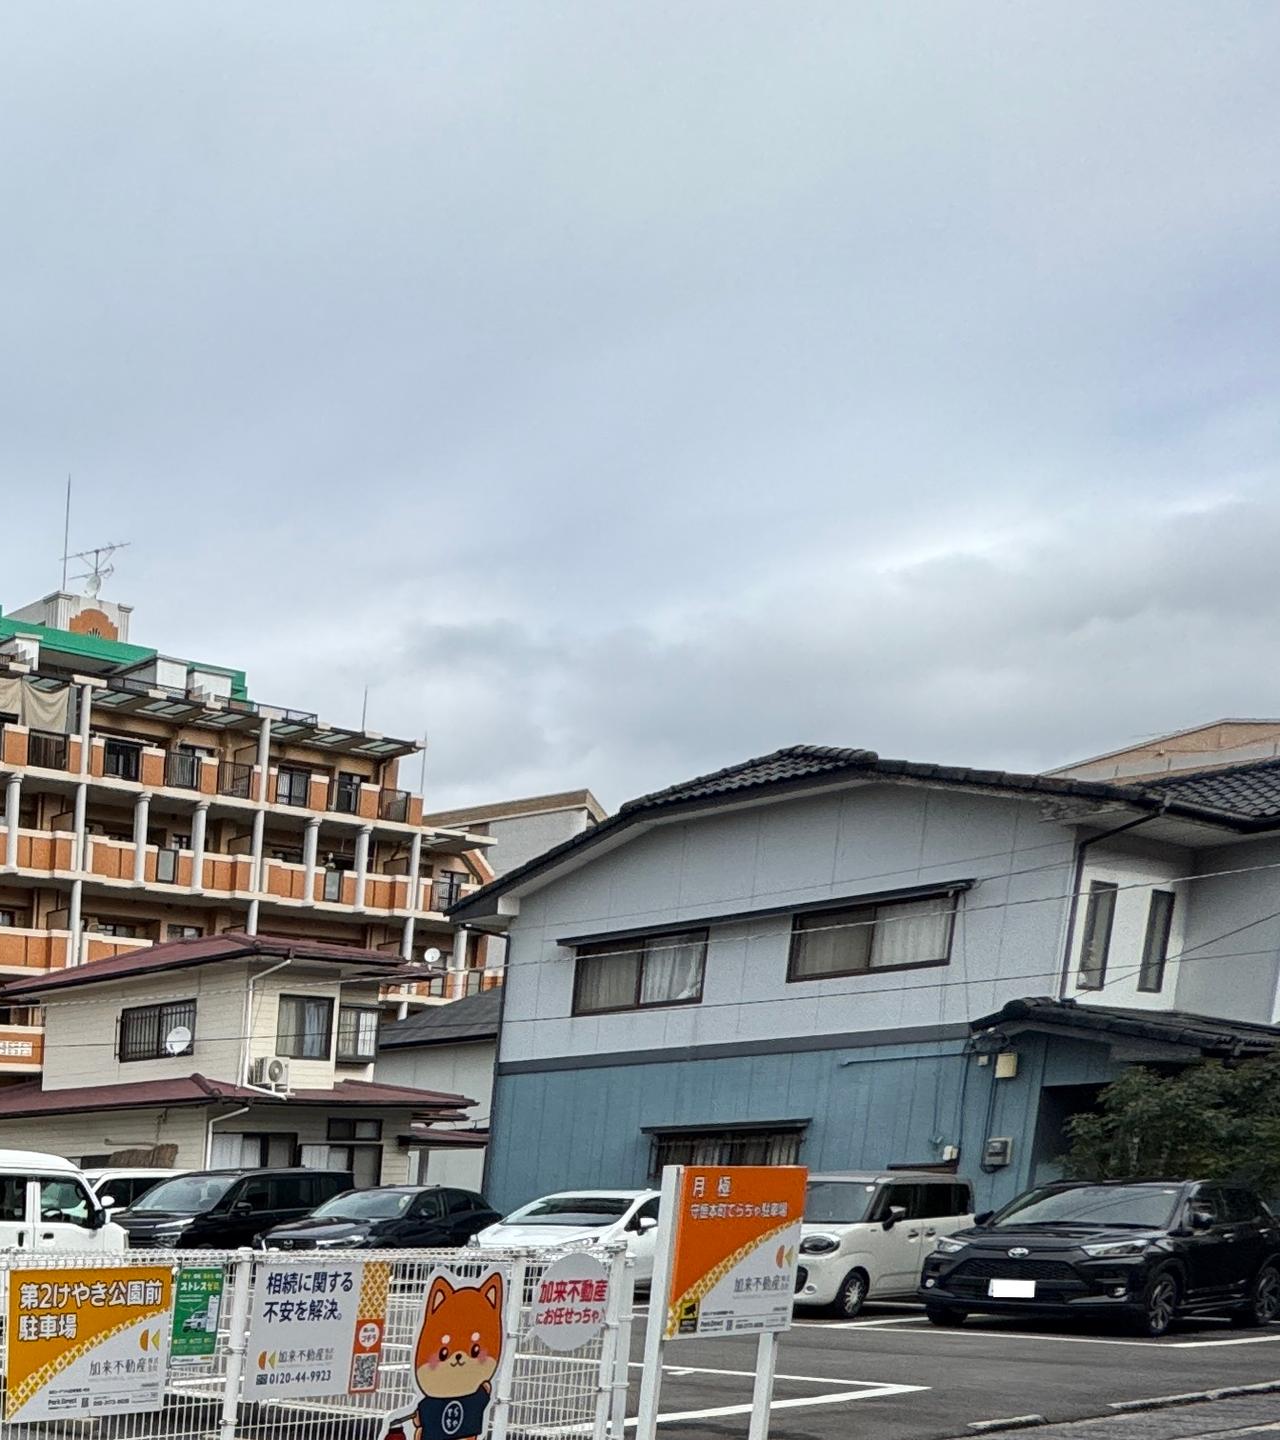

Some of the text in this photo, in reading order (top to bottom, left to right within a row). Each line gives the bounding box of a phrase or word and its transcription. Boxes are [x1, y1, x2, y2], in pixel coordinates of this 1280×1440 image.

[19, 1280, 163, 1309] 第2けやき公園前
[266, 1271, 353, 1295] 相続に関する
[538, 1279, 608, 1303] 加来不動産
[263, 1298, 342, 1323] 不安を解決。
[18, 1313, 77, 1341] 駐車場
[269, 1370, 331, 1384] 0120-44-9923
